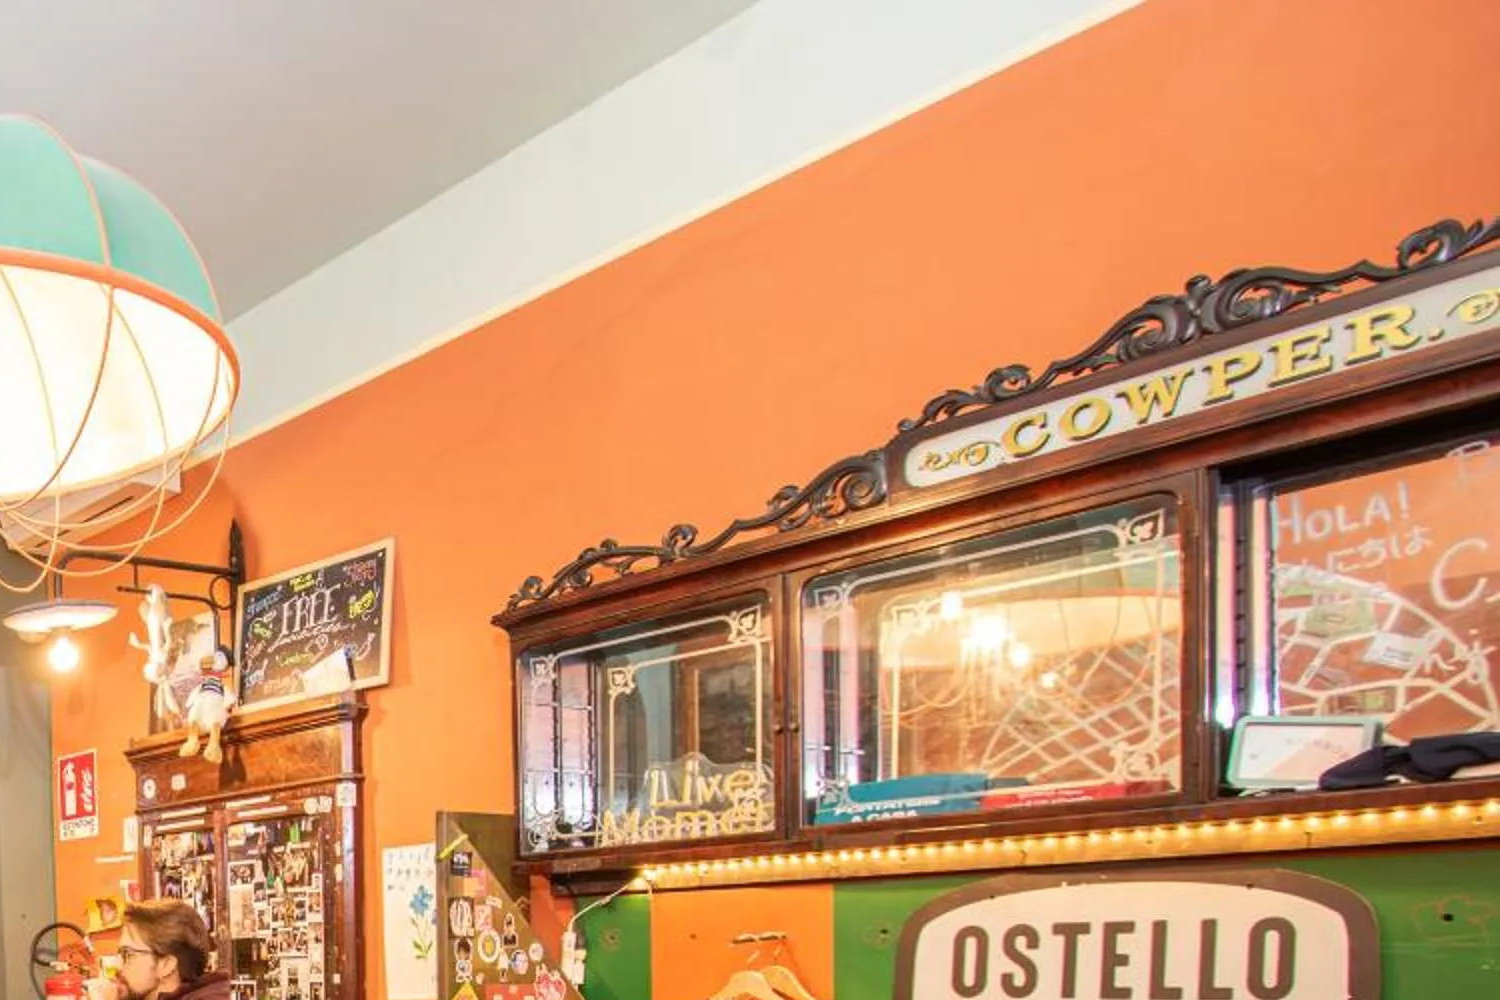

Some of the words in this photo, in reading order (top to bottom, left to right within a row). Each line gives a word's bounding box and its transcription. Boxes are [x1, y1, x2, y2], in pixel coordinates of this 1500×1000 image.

[1271, 479, 1409, 548] HOLA!
[281, 583, 341, 636] FREE
[951, 916, 1297, 1000] OSTELLO
